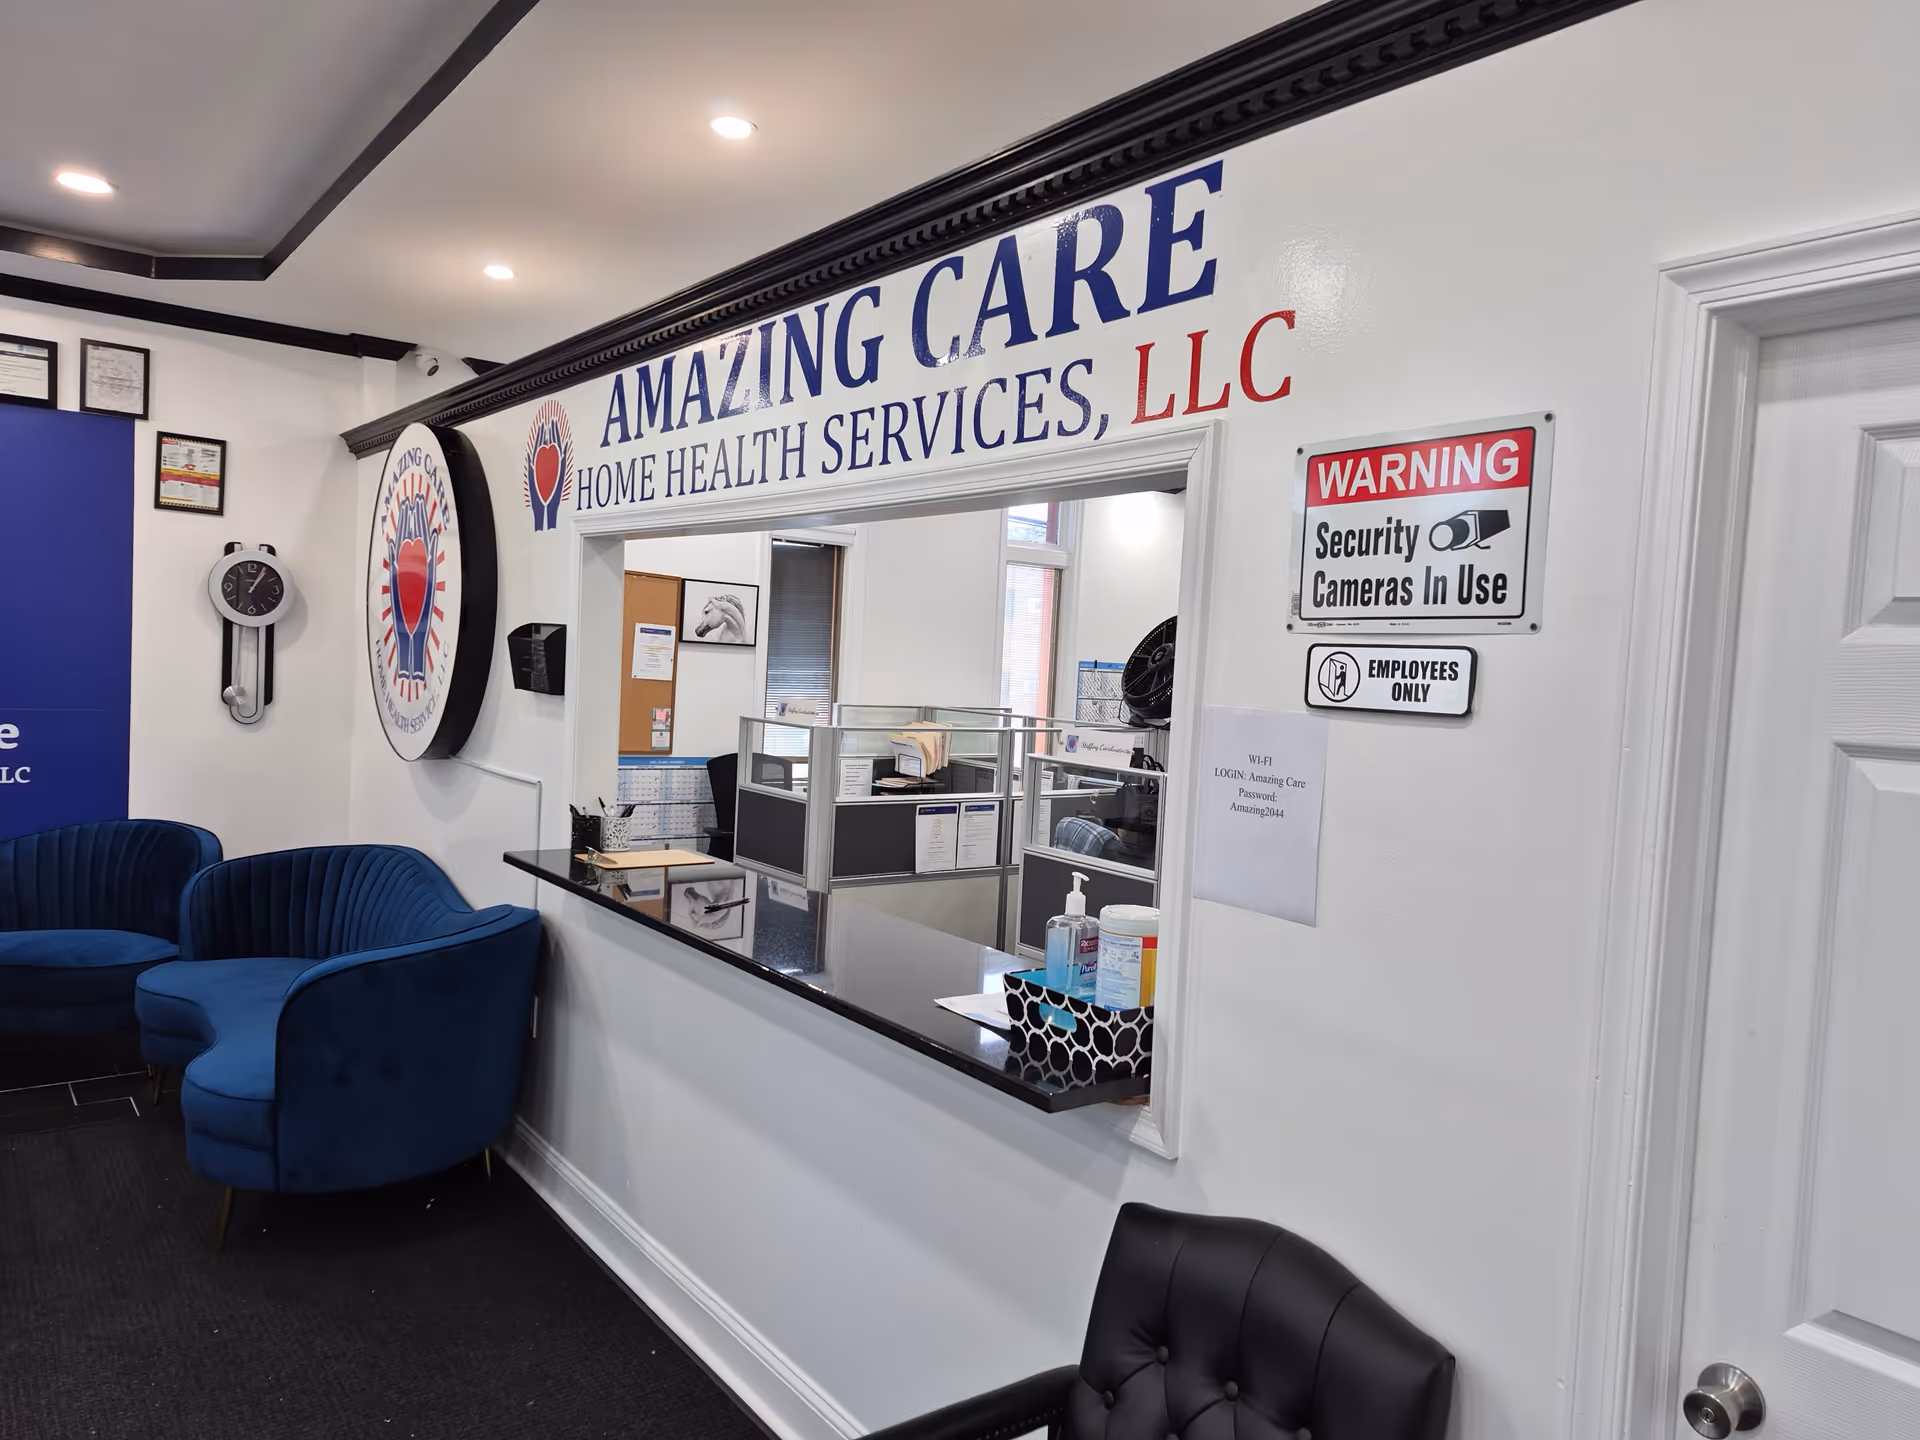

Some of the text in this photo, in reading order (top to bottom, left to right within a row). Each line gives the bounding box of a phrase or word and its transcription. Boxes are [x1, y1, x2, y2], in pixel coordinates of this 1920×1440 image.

[600, 160, 1224, 448] AMAZING CARE
[576, 309, 1296, 511] HOME HEALTH SERVICES, LLC
[1317, 438, 1519, 499] WARNING
[380, 446, 451, 533] AMAZING CARE
[1315, 516, 1420, 562] Security
[1312, 563, 1508, 608] Cameras In Use
[1368, 659, 1459, 681] EMPLOYEES
[1391, 682, 1431, 702] ONLY
[1248, 754, 1272, 766] WI-FI
[1214, 767, 1306, 788] LOGIN: Amazing Care
[1229, 801, 1284, 818] Amazing2044
[1238, 787, 1278, 802] Password:
